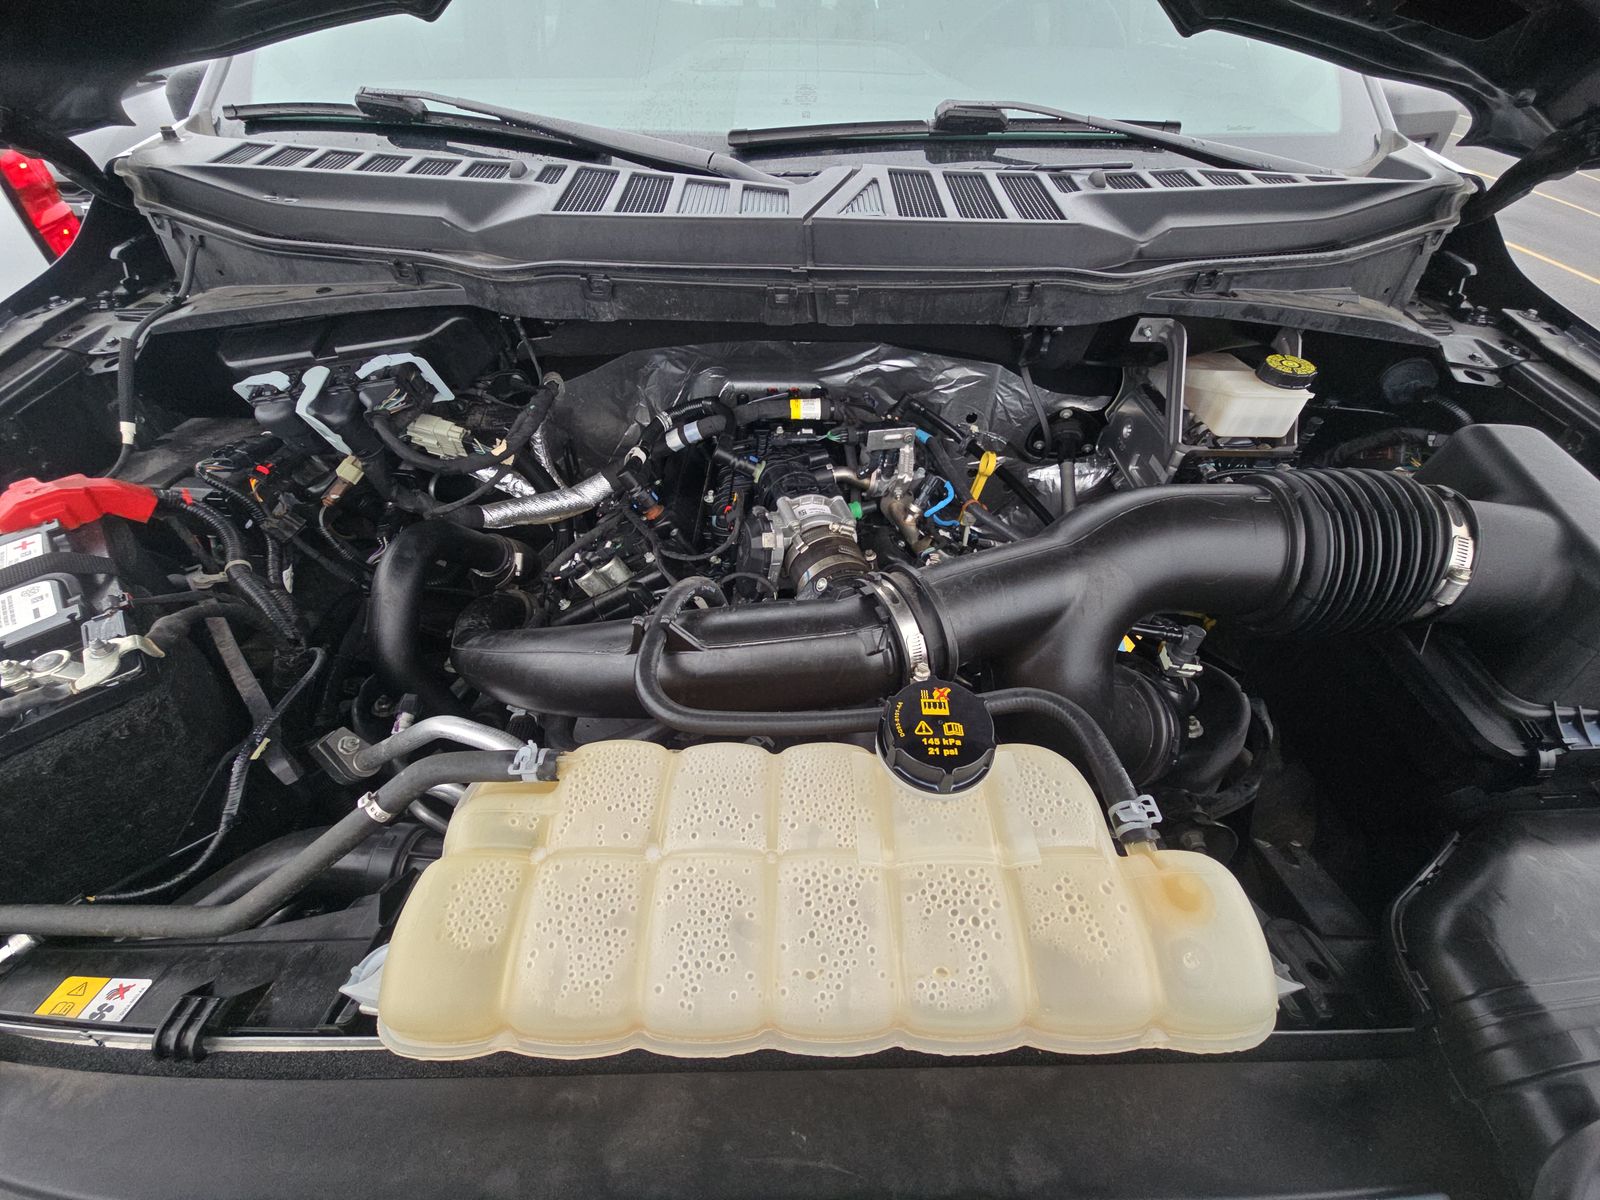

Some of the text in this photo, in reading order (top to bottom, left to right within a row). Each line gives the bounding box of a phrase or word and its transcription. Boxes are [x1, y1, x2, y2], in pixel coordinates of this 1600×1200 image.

[921, 737, 962, 746] 145 kPa
[927, 747, 959, 757] 21 psi
